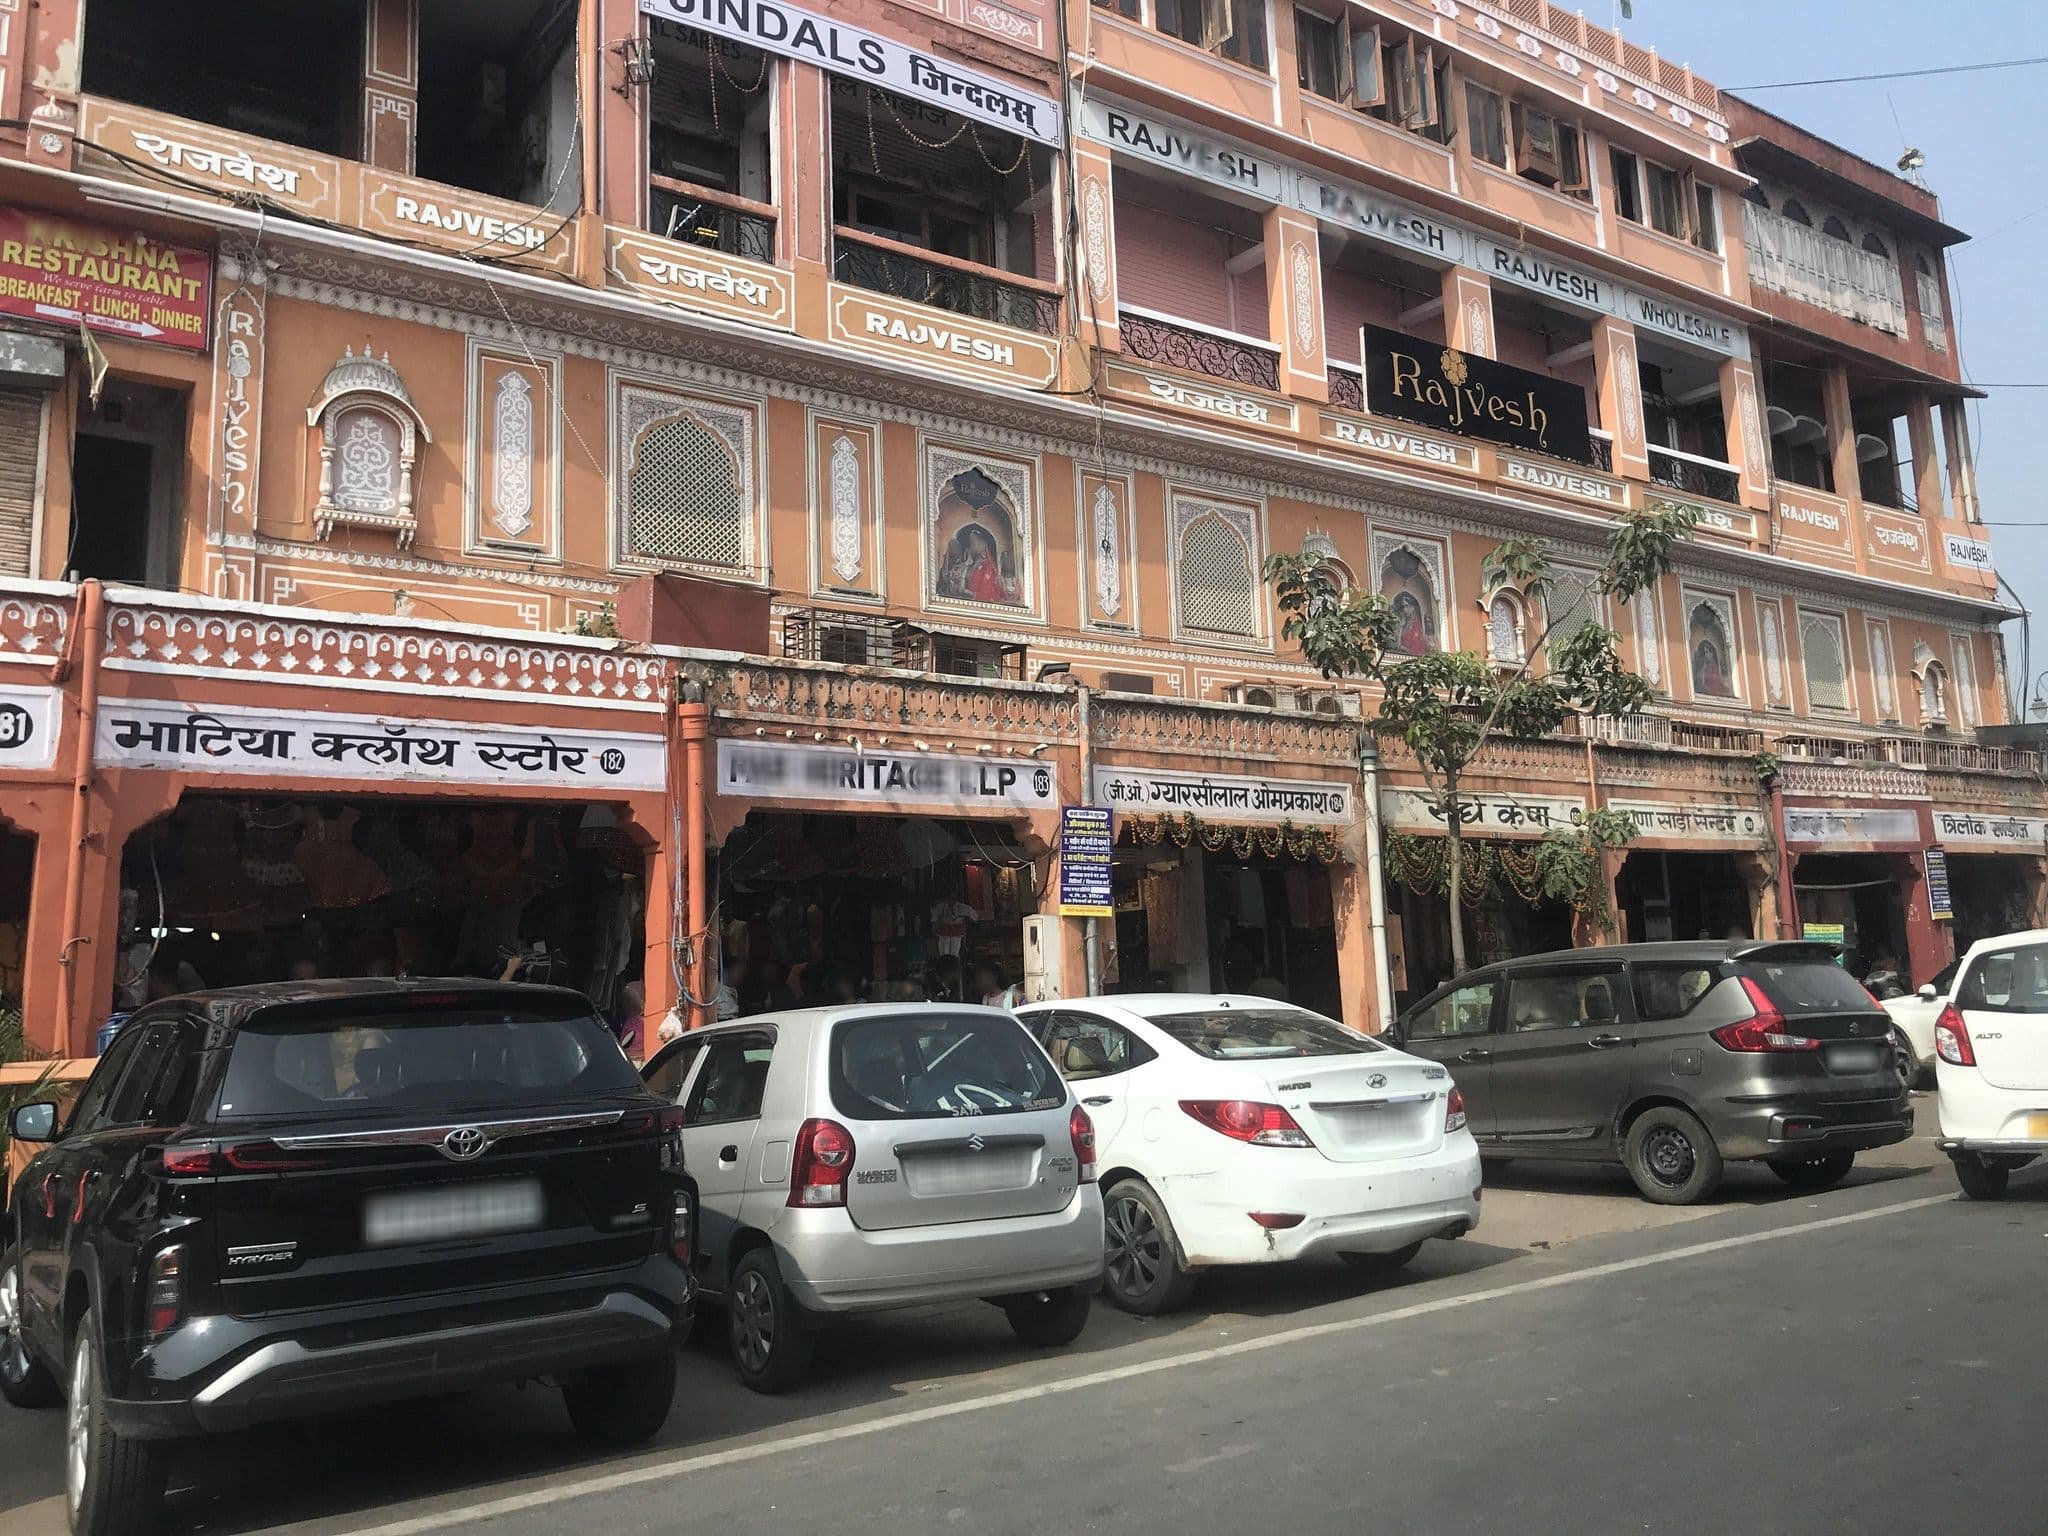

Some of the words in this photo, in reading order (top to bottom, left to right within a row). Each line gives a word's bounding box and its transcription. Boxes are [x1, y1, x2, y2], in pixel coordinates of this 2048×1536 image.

[132, 130, 300, 195] राजवेश
[396, 196, 546, 251] RAJVESH
[2, 239, 202, 303] RESTAURANT
[637, 252, 772, 307] राजवेश
[1494, 247, 1600, 304] RAJVESH
[0, 276, 82, 309] BREAKFAST
[93, 295, 140, 321] LUNCH
[152, 310, 202, 334] DINNER
[865, 311, 1015, 366] RAJVESH
[223, 310, 256, 514] Rajvesh
[1145, 375, 1270, 424] राजवेश
[1390, 349, 1548, 449] Rajvesh
[1335, 421, 1457, 465] RAJVESH
[1507, 462, 1611, 501] RAJVESH
[1780, 503, 1840, 532] RAJVESH
[1874, 525, 1919, 552] राजवेश
[1950, 542, 1988, 563] RAJVESH
[111, 714, 296, 759] भाटिया
[312, 727, 460, 769] क्लॉथ
[475, 735, 589, 774] स्टोर
[602, 749, 623, 772] 182
[1034, 774, 1050, 794] 183
[1975, 1032, 2003, 1040] ALTO
[228, 1251, 294, 1266] HYRYDER
